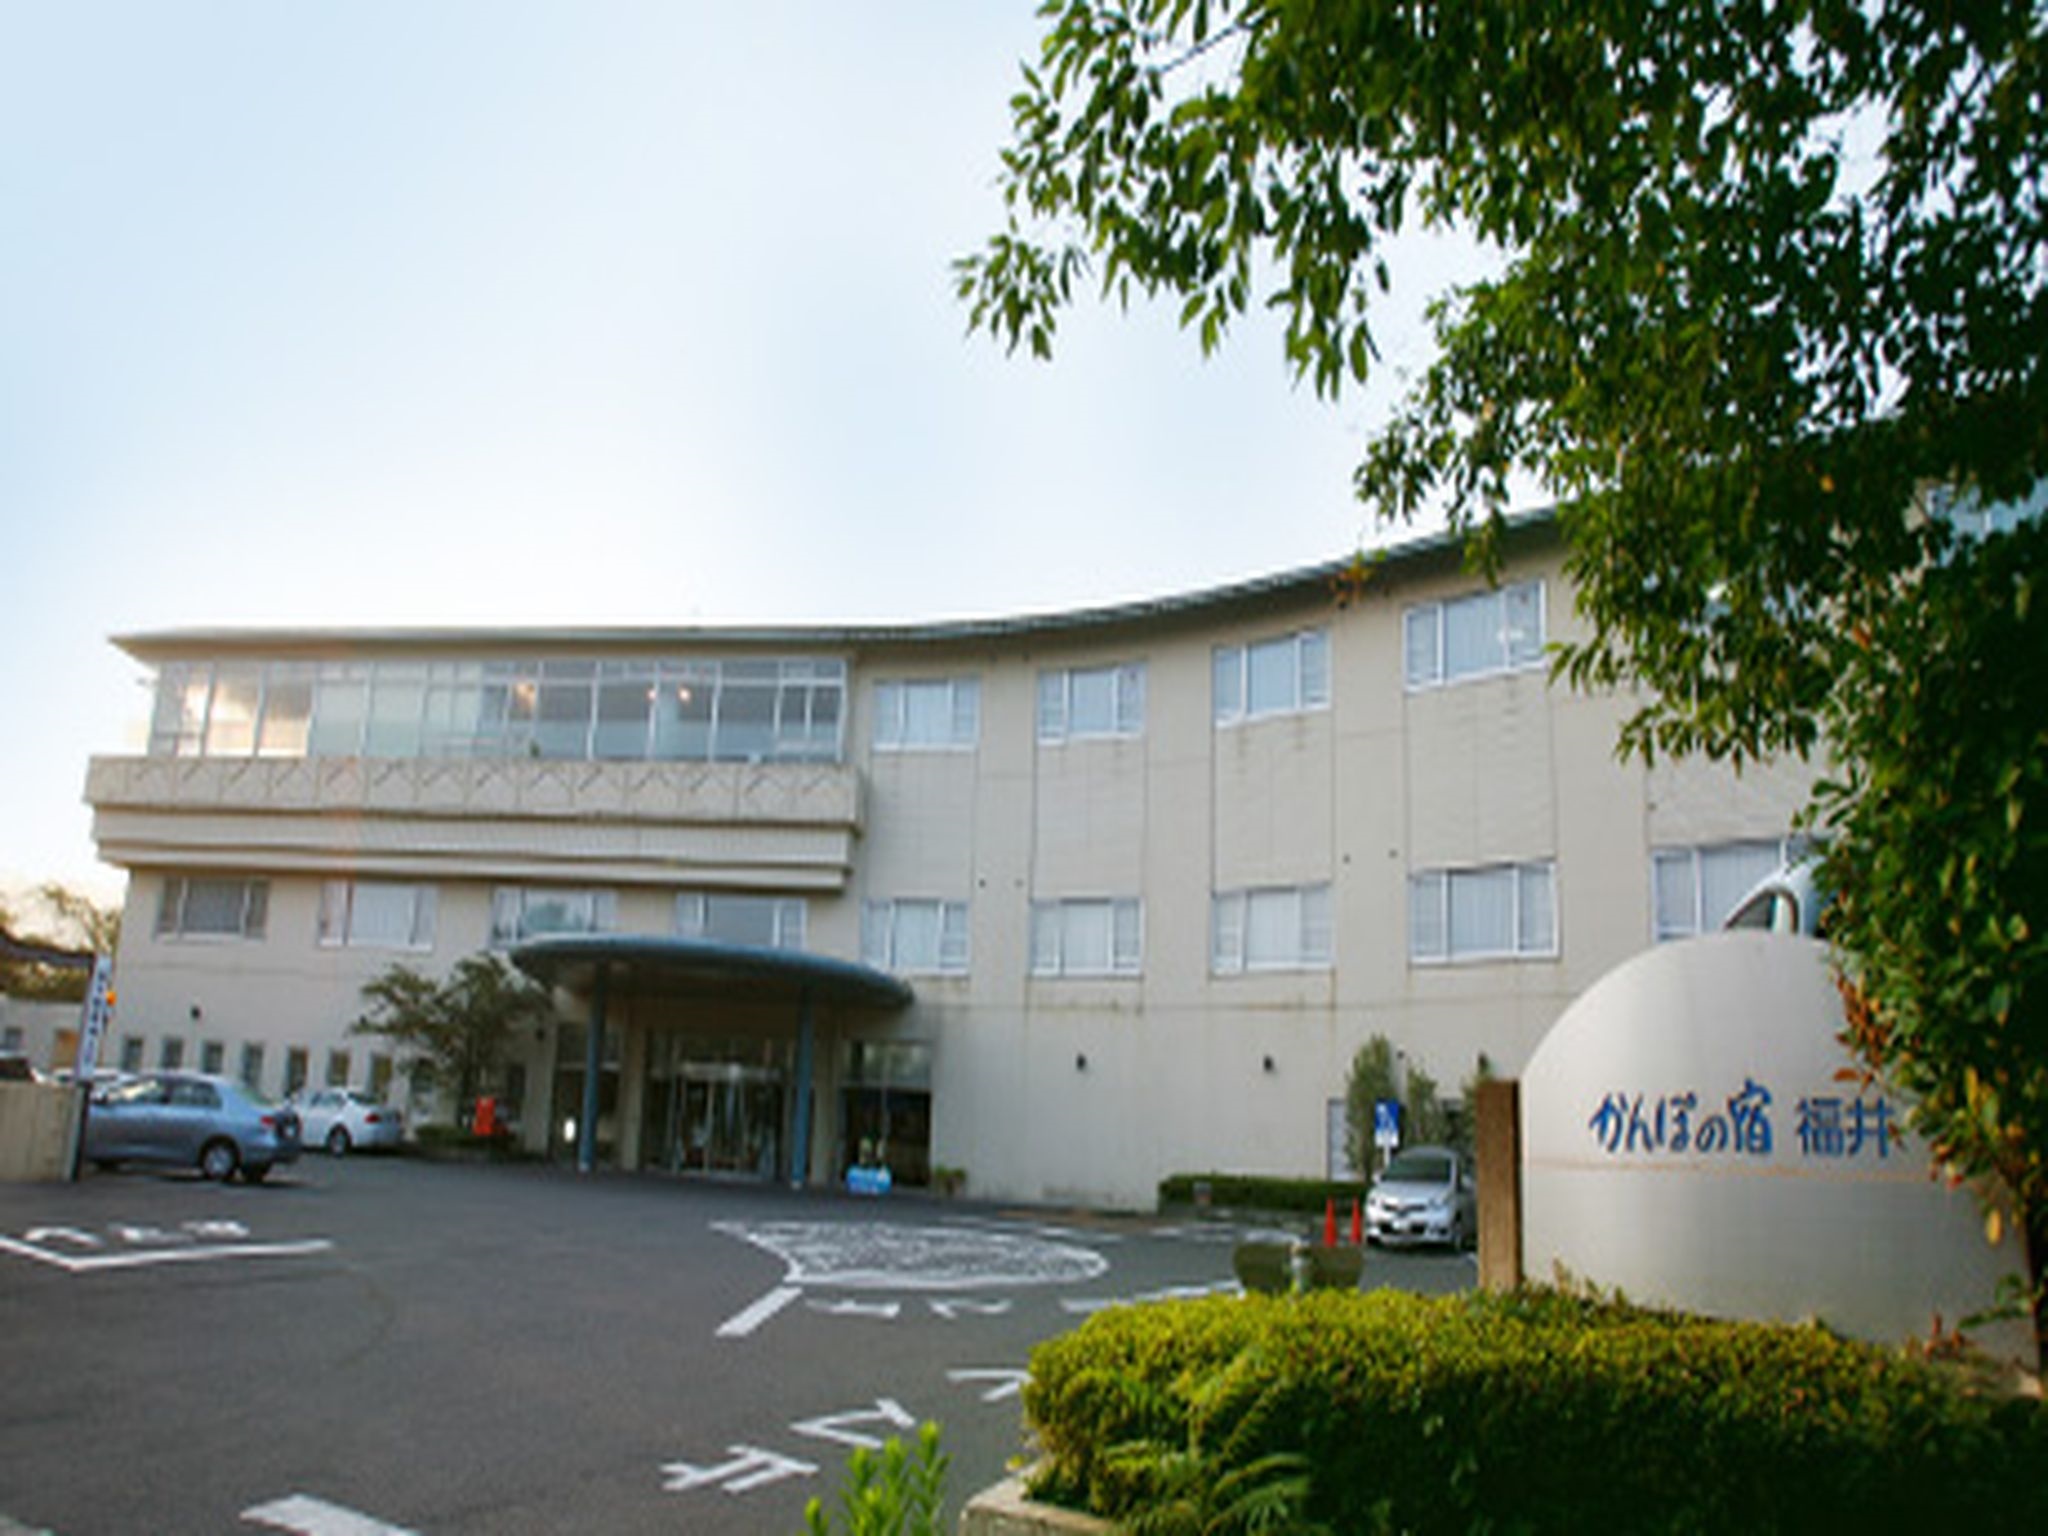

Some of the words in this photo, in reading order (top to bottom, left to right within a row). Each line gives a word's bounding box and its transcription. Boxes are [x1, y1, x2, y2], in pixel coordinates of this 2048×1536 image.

[1588, 1078, 1773, 1155] かんぽの宿
[1795, 1096, 1896, 1159] 福井
